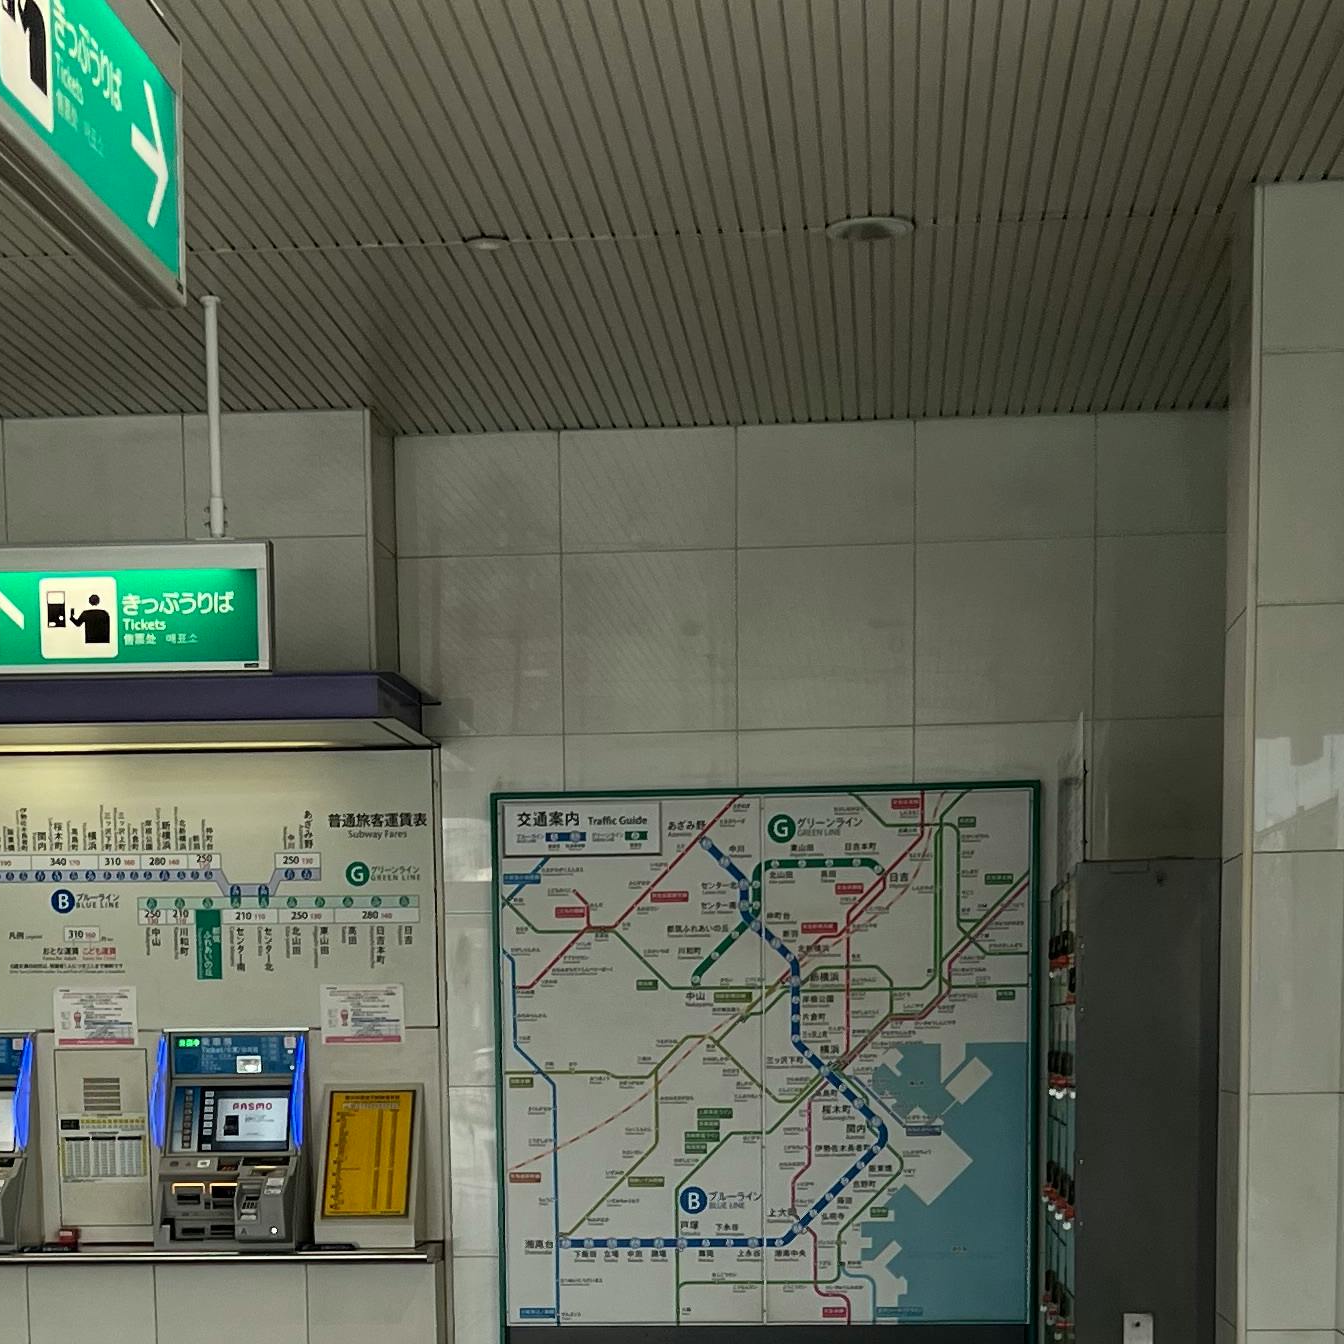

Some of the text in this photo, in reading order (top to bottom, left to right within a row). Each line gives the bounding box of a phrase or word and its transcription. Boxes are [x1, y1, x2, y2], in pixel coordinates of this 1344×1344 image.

[53, 0, 123, 111] きっぷうりば
[122, 591, 235, 616] きっぷうりば
[123, 619, 166, 631] Tickets
[328, 812, 427, 828] 普通旅客運賃表
[517, 811, 648, 828] 交通案内 Traffic Guide
[797, 817, 863, 828] グリーンライン
[667, 819, 707, 832] あざみ野
[347, 830, 408, 841] Subway Fares
[50, 857, 67, 866] 340
[104, 857, 122, 866] 310
[149, 857, 166, 866] 280
[283, 856, 300, 865] 250
[890, 872, 909, 882] 日吉
[235, 911, 252, 920] 210
[291, 911, 308, 920] 250
[362, 911, 379, 920] 280
[68, 930, 84, 939] 310
[686, 992, 706, 1002] 中山
[232, 1102, 273, 1111] PASMO
[709, 1191, 762, 1202] ブルーライン
